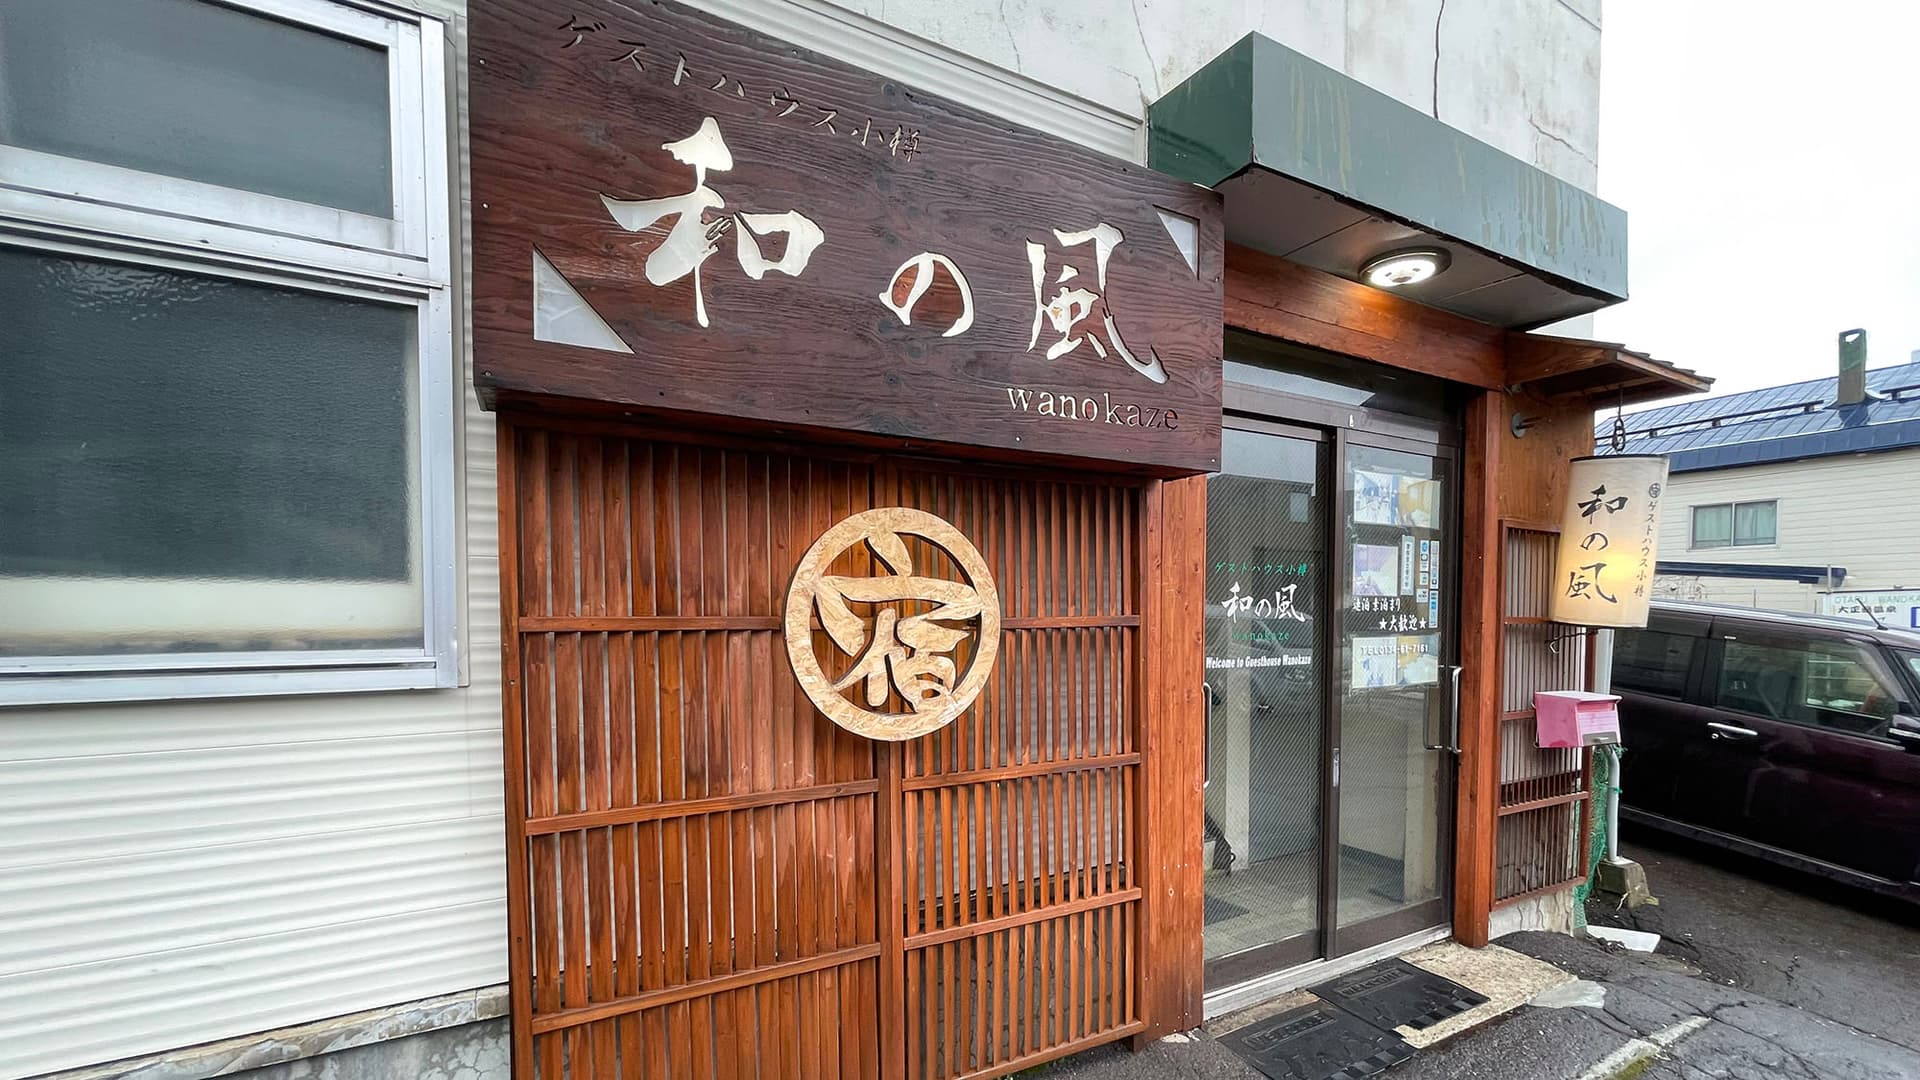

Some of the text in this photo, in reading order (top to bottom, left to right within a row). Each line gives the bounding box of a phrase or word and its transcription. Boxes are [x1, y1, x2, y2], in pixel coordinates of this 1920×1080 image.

[558, 14, 921, 163] ゲストハウス小樽
[600, 115, 1169, 385] 和の風
[1006, 385, 1179, 431] wanokaze
[1565, 484, 1629, 604] 和の風
[1221, 581, 1306, 624] 和の風
[1206, 656, 1235, 669] Welcome
[1236, 657, 1244, 668] to
[1245, 655, 1281, 668] Guesthouse
